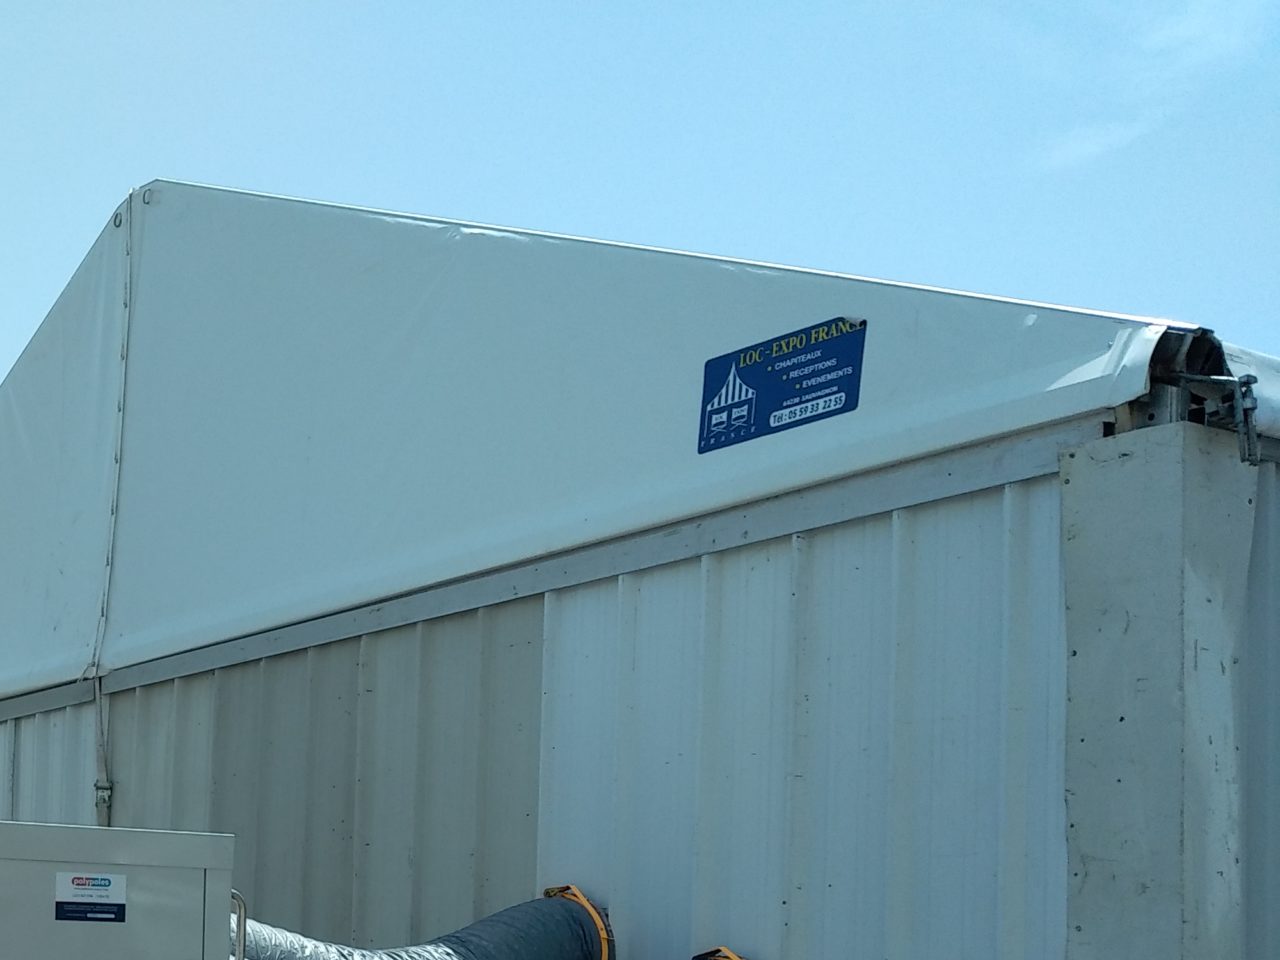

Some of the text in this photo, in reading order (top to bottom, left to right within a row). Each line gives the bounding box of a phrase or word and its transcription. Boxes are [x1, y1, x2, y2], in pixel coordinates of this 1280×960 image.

[774, 349, 822, 370] CHAPITEAUX
[789, 357, 837, 379] RECEPTIONS
[788, 408, 798, 420] 05
[799, 405, 809, 416] 59
[809, 402, 820, 414] 33
[822, 398, 832, 410] 22
[833, 394, 844, 407] 55
